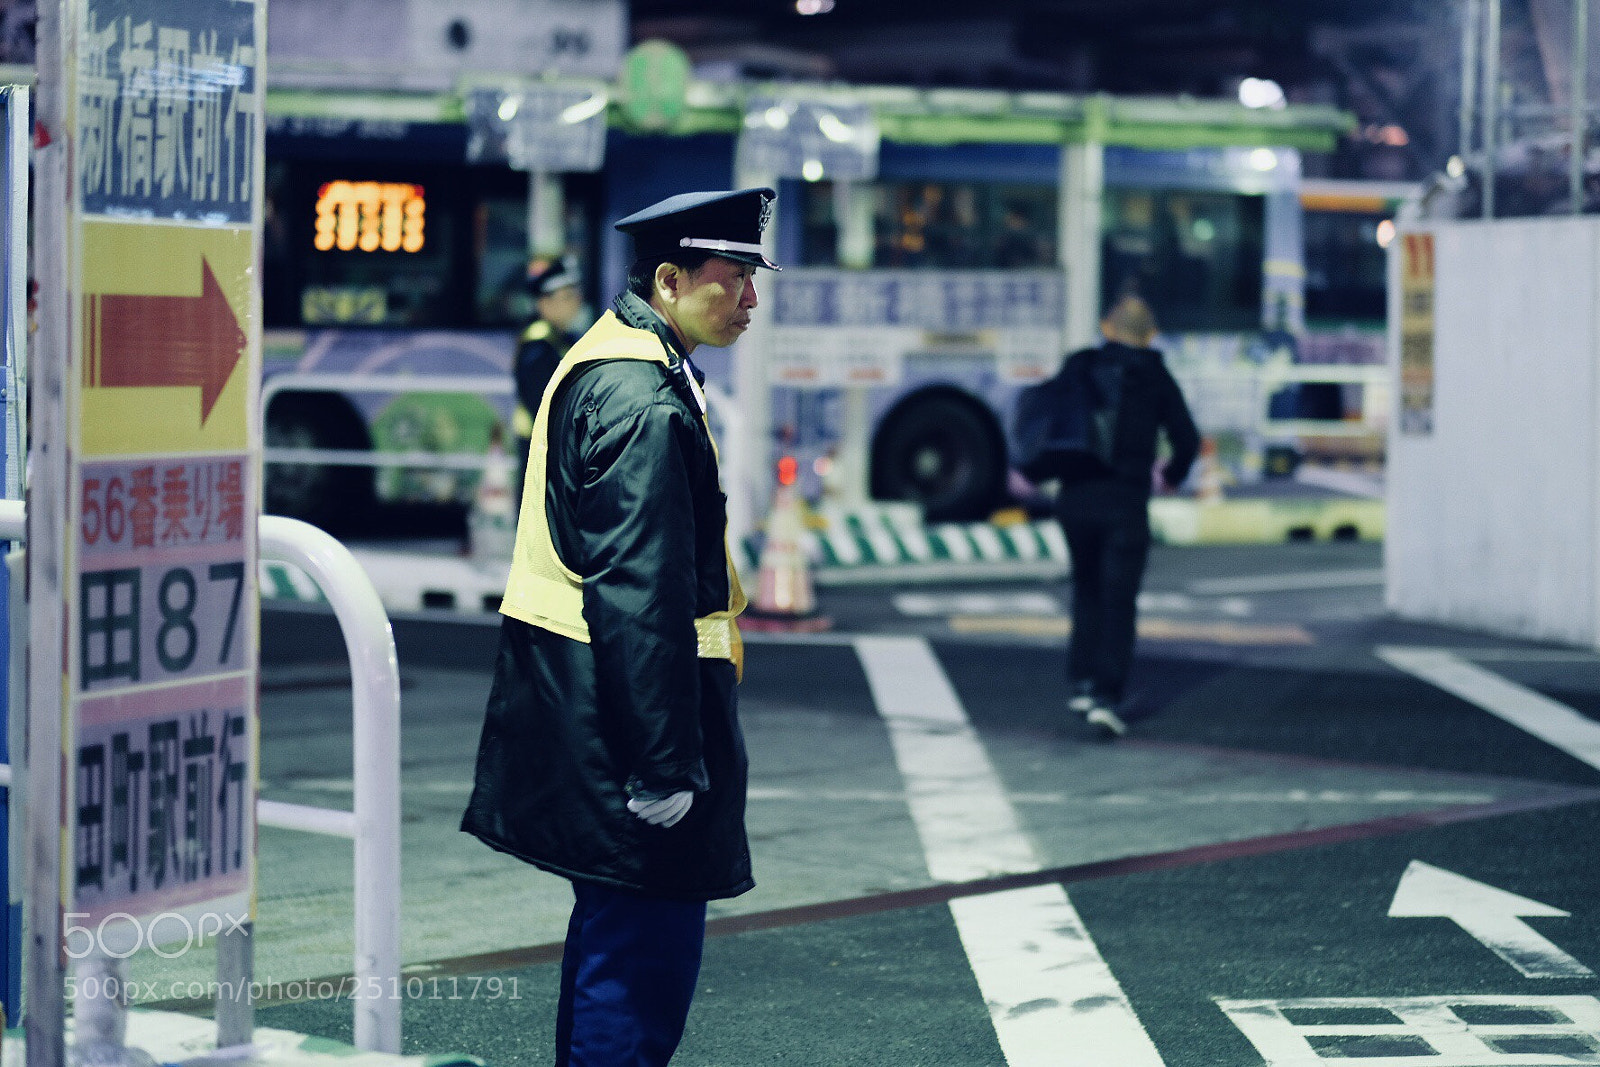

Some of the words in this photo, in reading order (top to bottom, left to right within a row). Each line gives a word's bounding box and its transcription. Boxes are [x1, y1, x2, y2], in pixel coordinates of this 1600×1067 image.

[79, 10, 254, 203] 新橋駅前行
[83, 461, 245, 547] 56番乗り場
[77, 709, 246, 897] 田町駅前行
